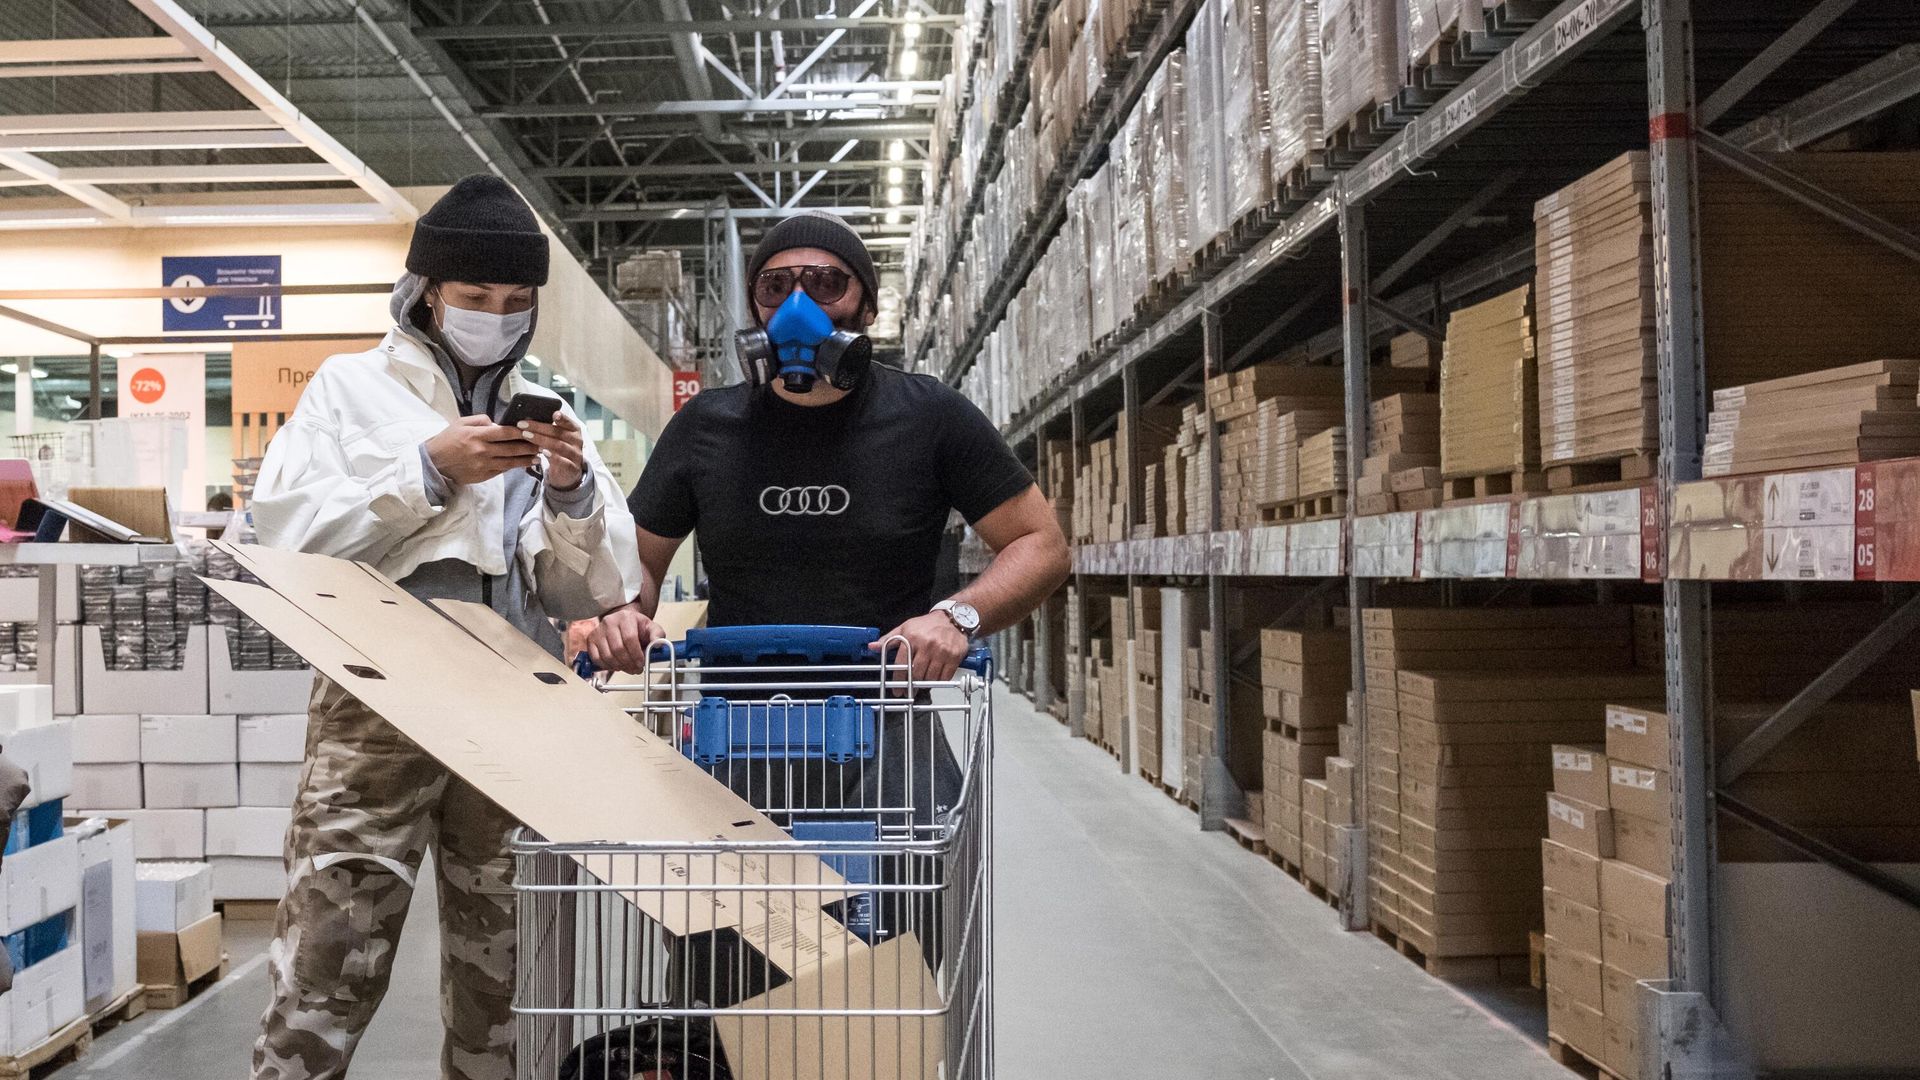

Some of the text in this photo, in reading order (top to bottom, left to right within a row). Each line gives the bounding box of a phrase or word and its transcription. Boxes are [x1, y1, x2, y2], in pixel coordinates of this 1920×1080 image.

[131, 380, 162, 392] -72%
[675, 380, 700, 396] 30
[1858, 488, 1874, 511] 28
[1644, 508, 1655, 526] 28
[1645, 551, 1657, 569] 06
[1857, 543, 1874, 566] 05
